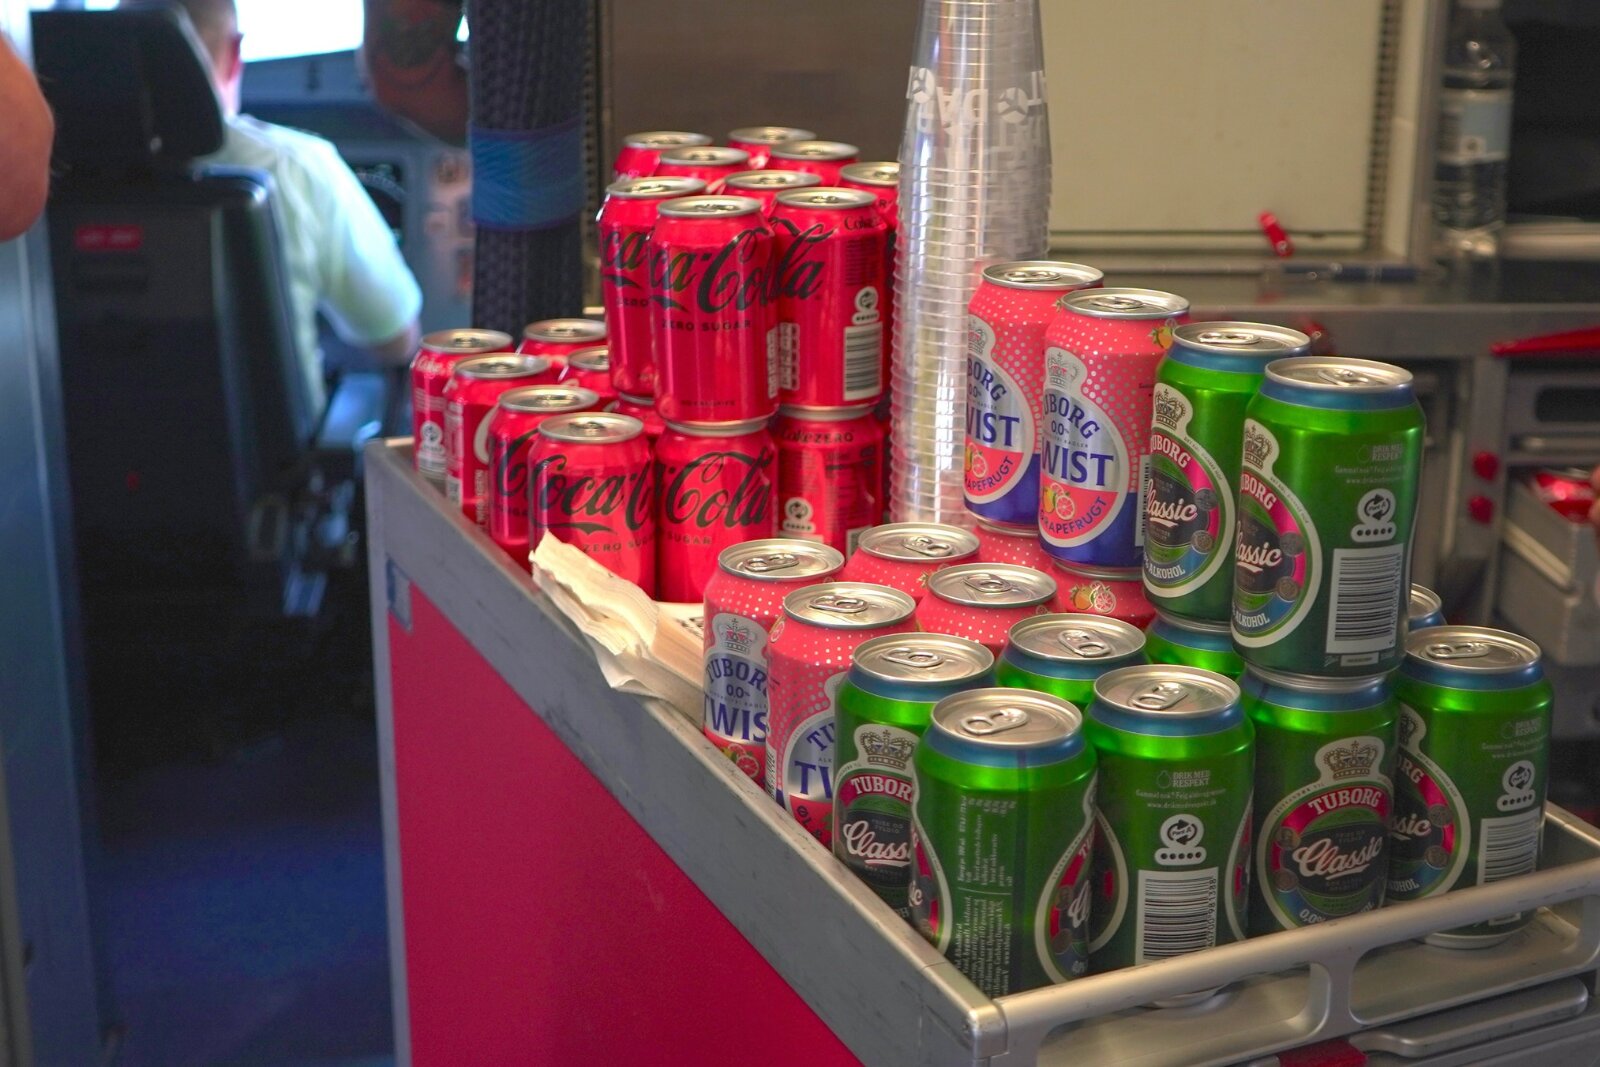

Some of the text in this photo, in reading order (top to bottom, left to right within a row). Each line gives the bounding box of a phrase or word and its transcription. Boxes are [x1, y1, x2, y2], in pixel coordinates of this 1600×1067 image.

[706, 658, 767, 697] TUBOR
[851, 776, 912, 802] TUBOR
[1308, 787, 1382, 816] TUBORG
[843, 820, 912, 860] Class
[1292, 836, 1384, 878] Classic
